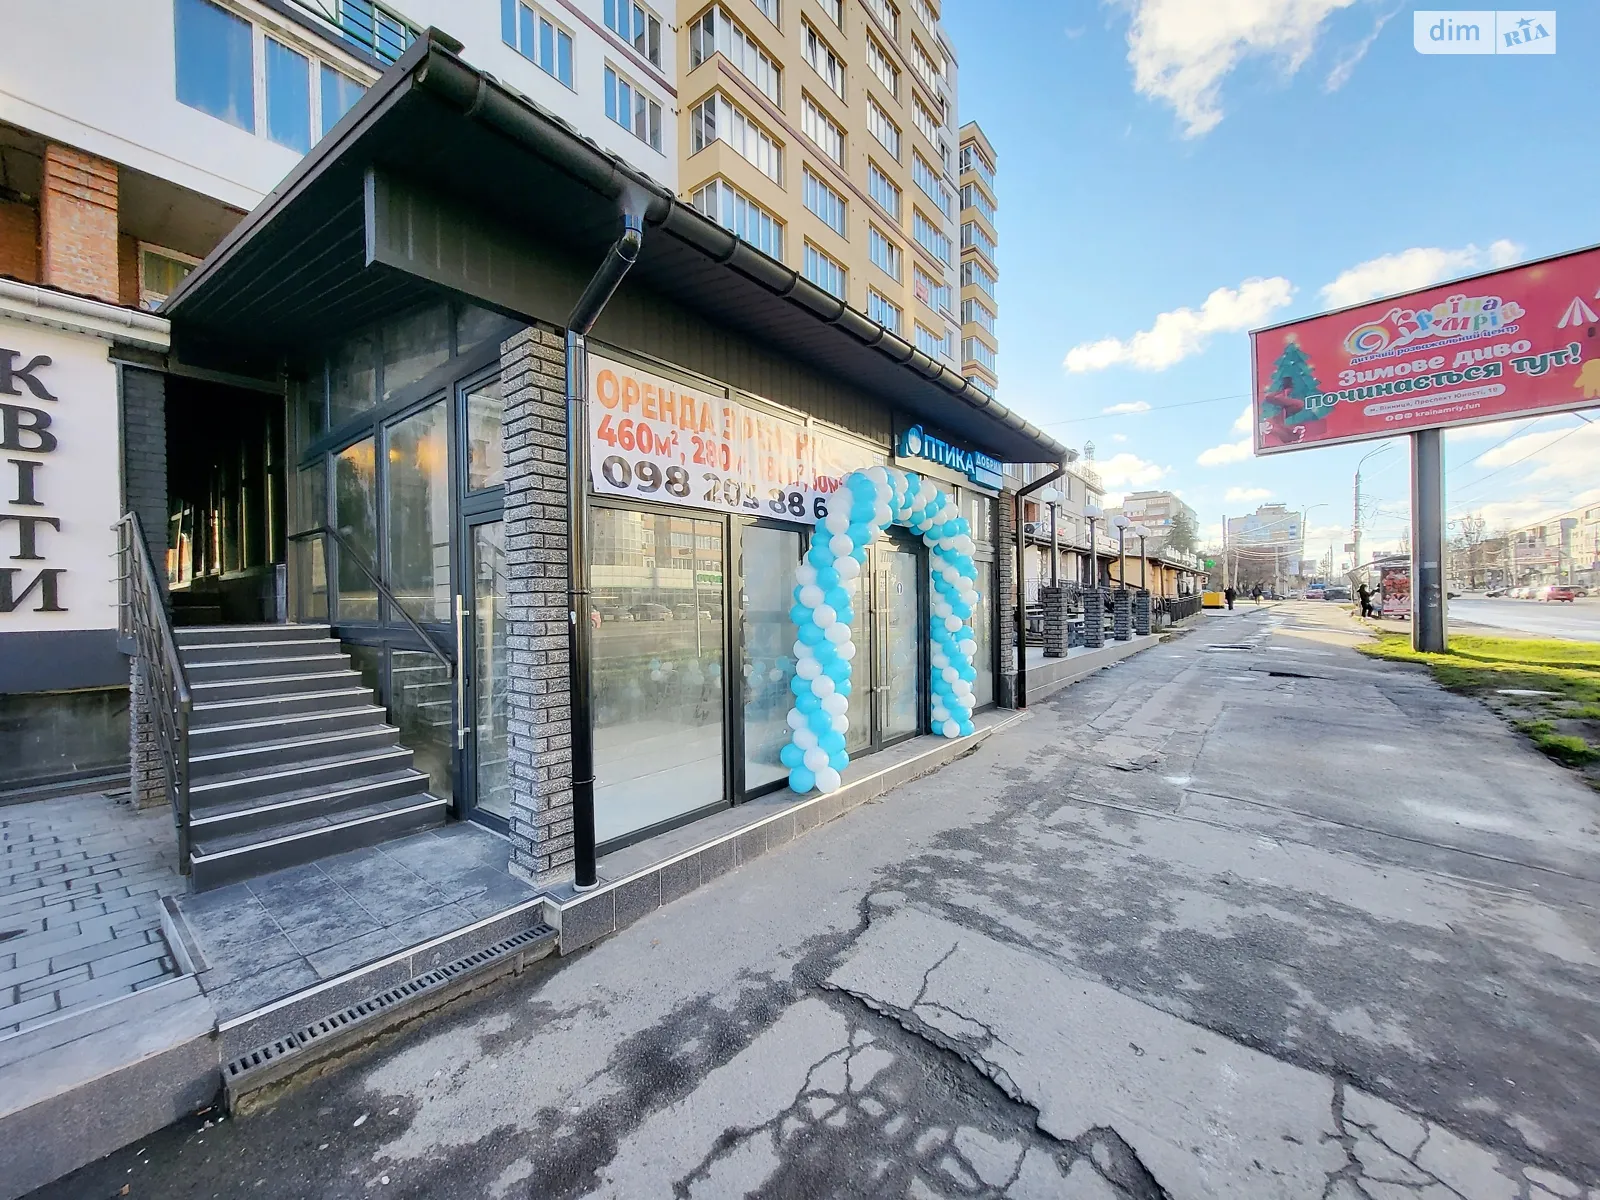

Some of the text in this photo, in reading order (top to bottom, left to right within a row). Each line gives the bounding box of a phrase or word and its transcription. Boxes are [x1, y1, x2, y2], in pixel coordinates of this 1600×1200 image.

[1397, 332, 1481, 357] розважальний
[1482, 324, 1519, 340] центр
[1304, 341, 1583, 410] починається тут!
[1338, 356, 1445, 386] Зимове
[596, 369, 717, 436] ОРЕНДА
[602, 455, 691, 498] 098
